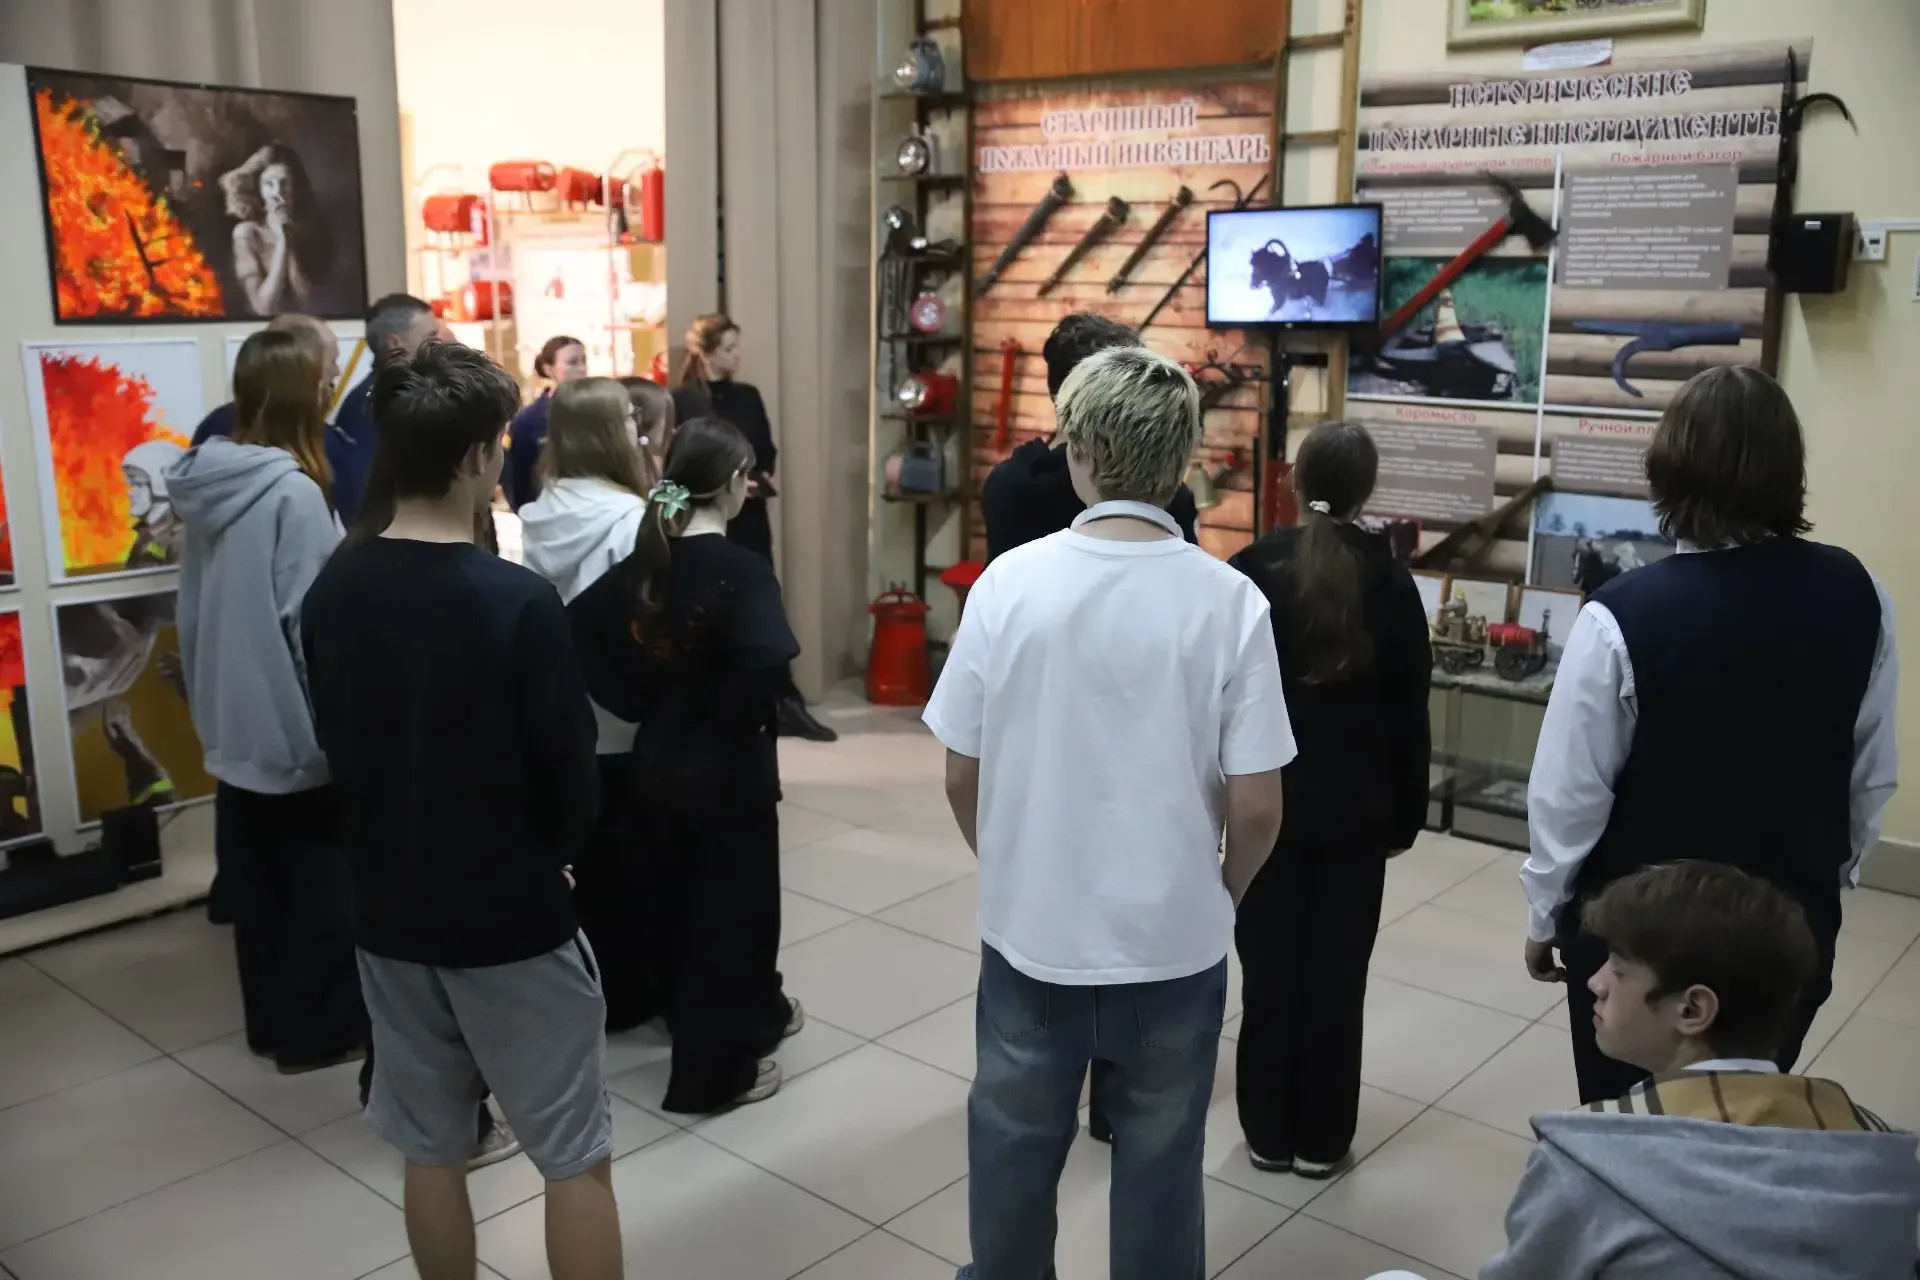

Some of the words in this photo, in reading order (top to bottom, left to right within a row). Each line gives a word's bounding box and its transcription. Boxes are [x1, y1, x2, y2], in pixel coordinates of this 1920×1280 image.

[1449, 69, 1692, 110] ИСТОРИЧЕСКИЕ
[1042, 99, 1195, 135] СТАРИННЫЙ
[983, 140, 1109, 170] ПОЖАРНЫЙ
[1117, 134, 1269, 165] ИНВЕНТАРЬ
[1368, 121, 1526, 152] ПОЖАРНЫЕ
[1611, 151, 1692, 168] Пожарный
[1697, 149, 1742, 164] багор
[1396, 407, 1476, 424] Коромысло
[1579, 418, 1632, 434] Ручной
